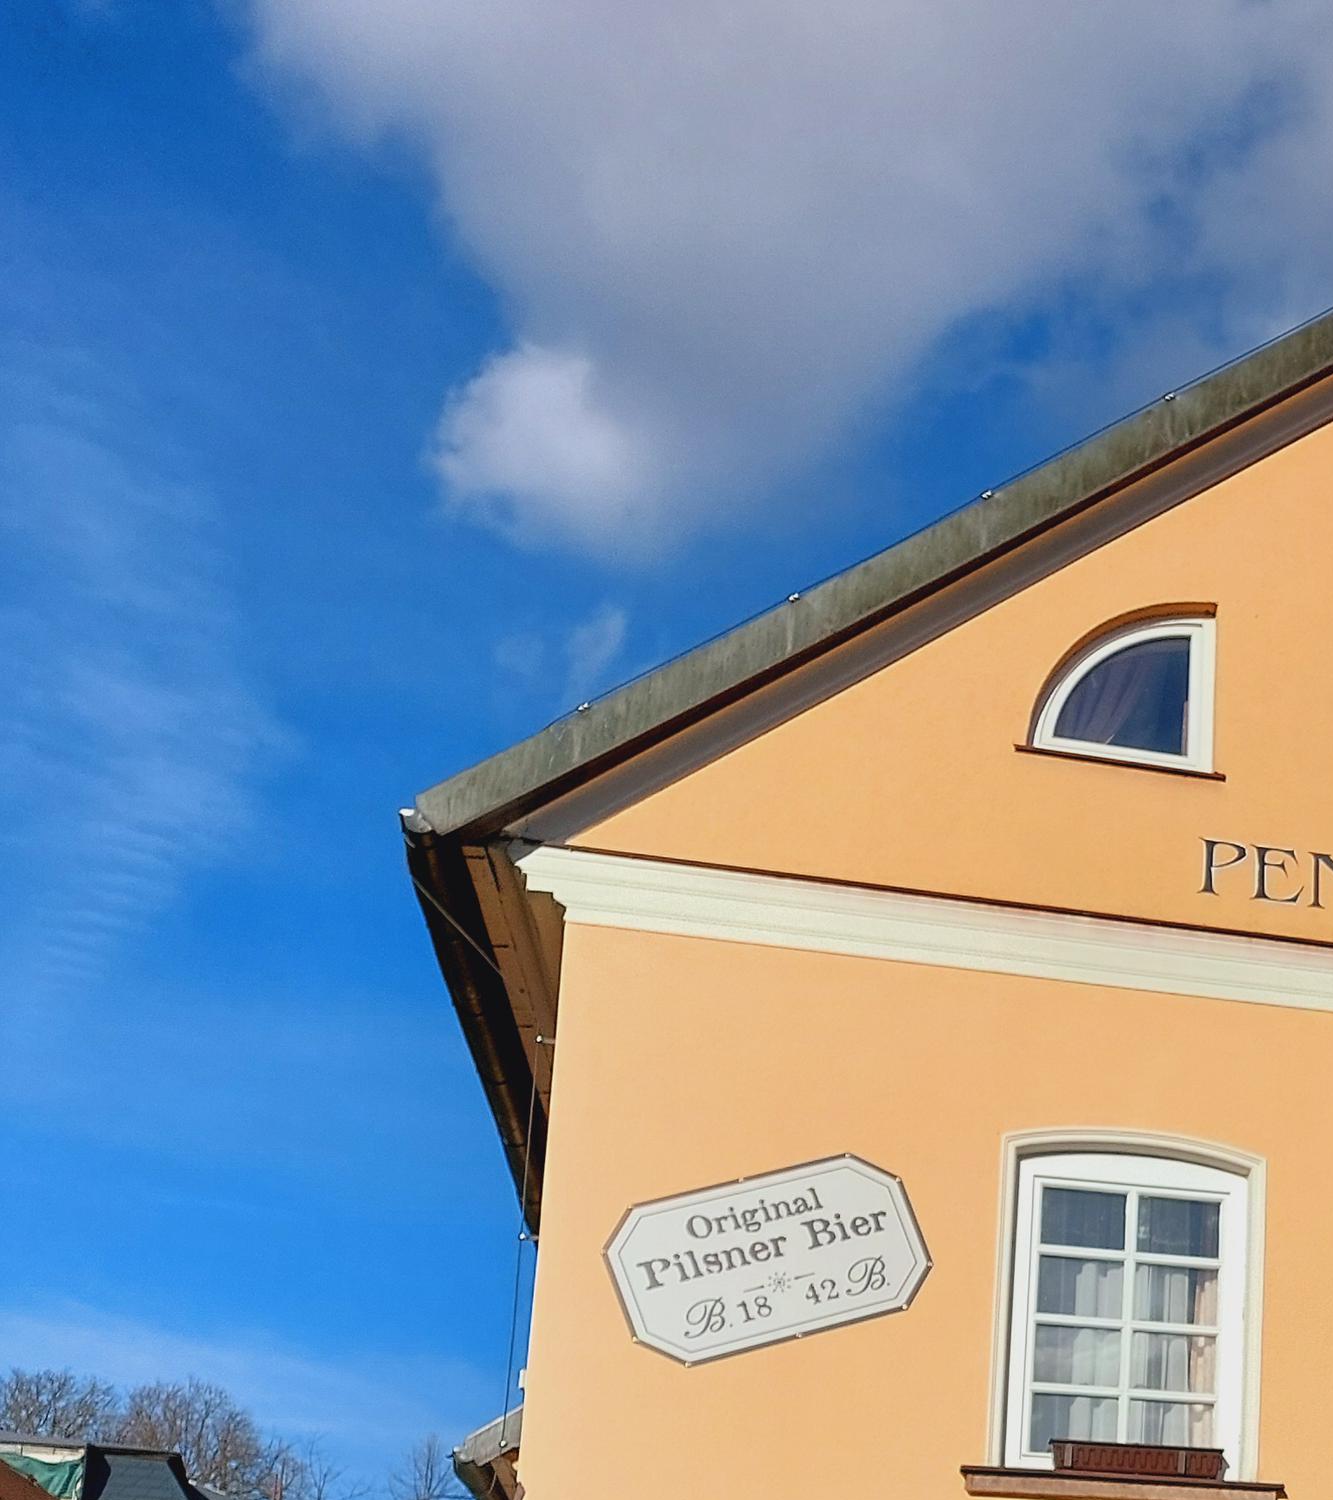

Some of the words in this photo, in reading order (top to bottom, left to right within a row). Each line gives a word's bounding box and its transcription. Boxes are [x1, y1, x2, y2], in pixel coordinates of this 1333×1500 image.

[686, 1187, 824, 1239] Original
[637, 1236, 787, 1290] Pilsner
[800, 1210, 887, 1250] Bier
[737, 1296, 773, 1324] 18
[804, 1278, 840, 1305] 42
